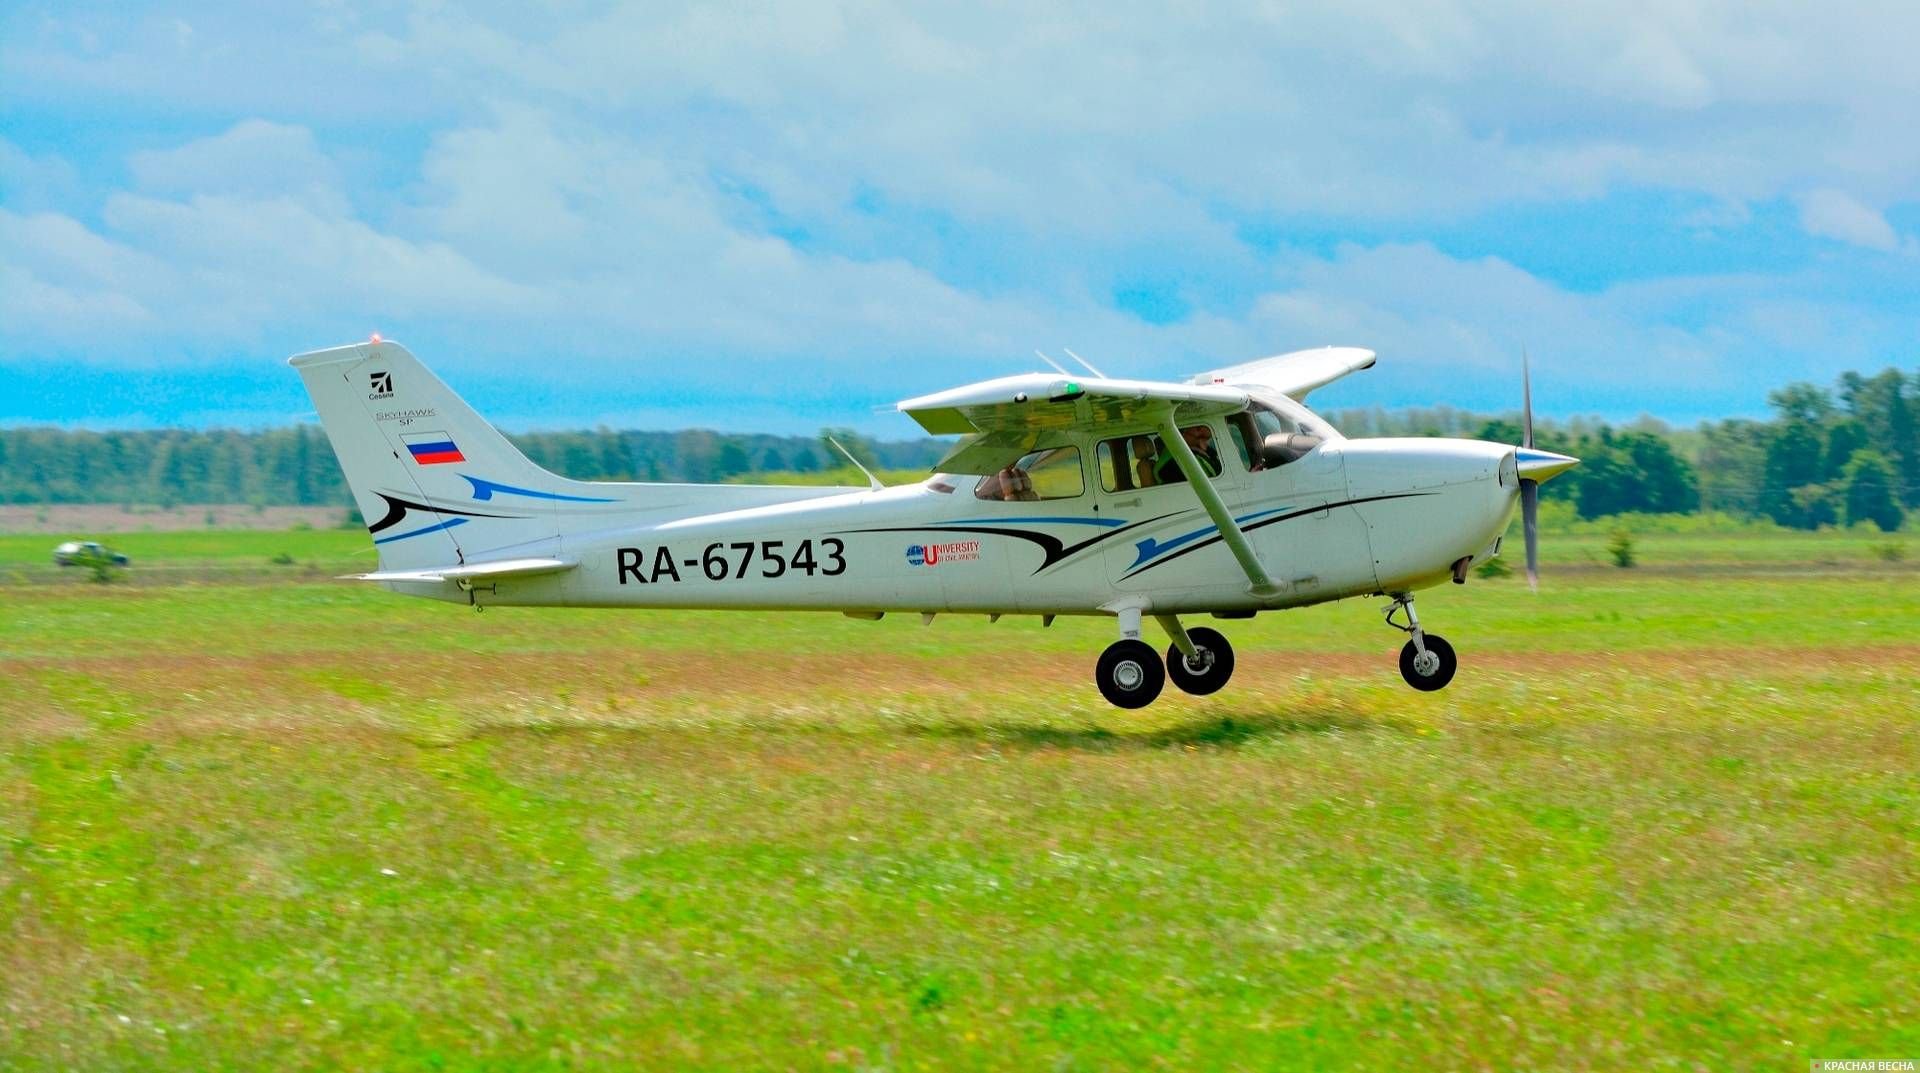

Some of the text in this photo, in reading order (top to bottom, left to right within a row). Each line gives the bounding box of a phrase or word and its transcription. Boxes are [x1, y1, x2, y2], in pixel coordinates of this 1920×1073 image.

[368, 393, 394, 401] Cessna
[616, 538, 847, 585] RA-67543
[923, 541, 980, 566] UNIVERSITY
